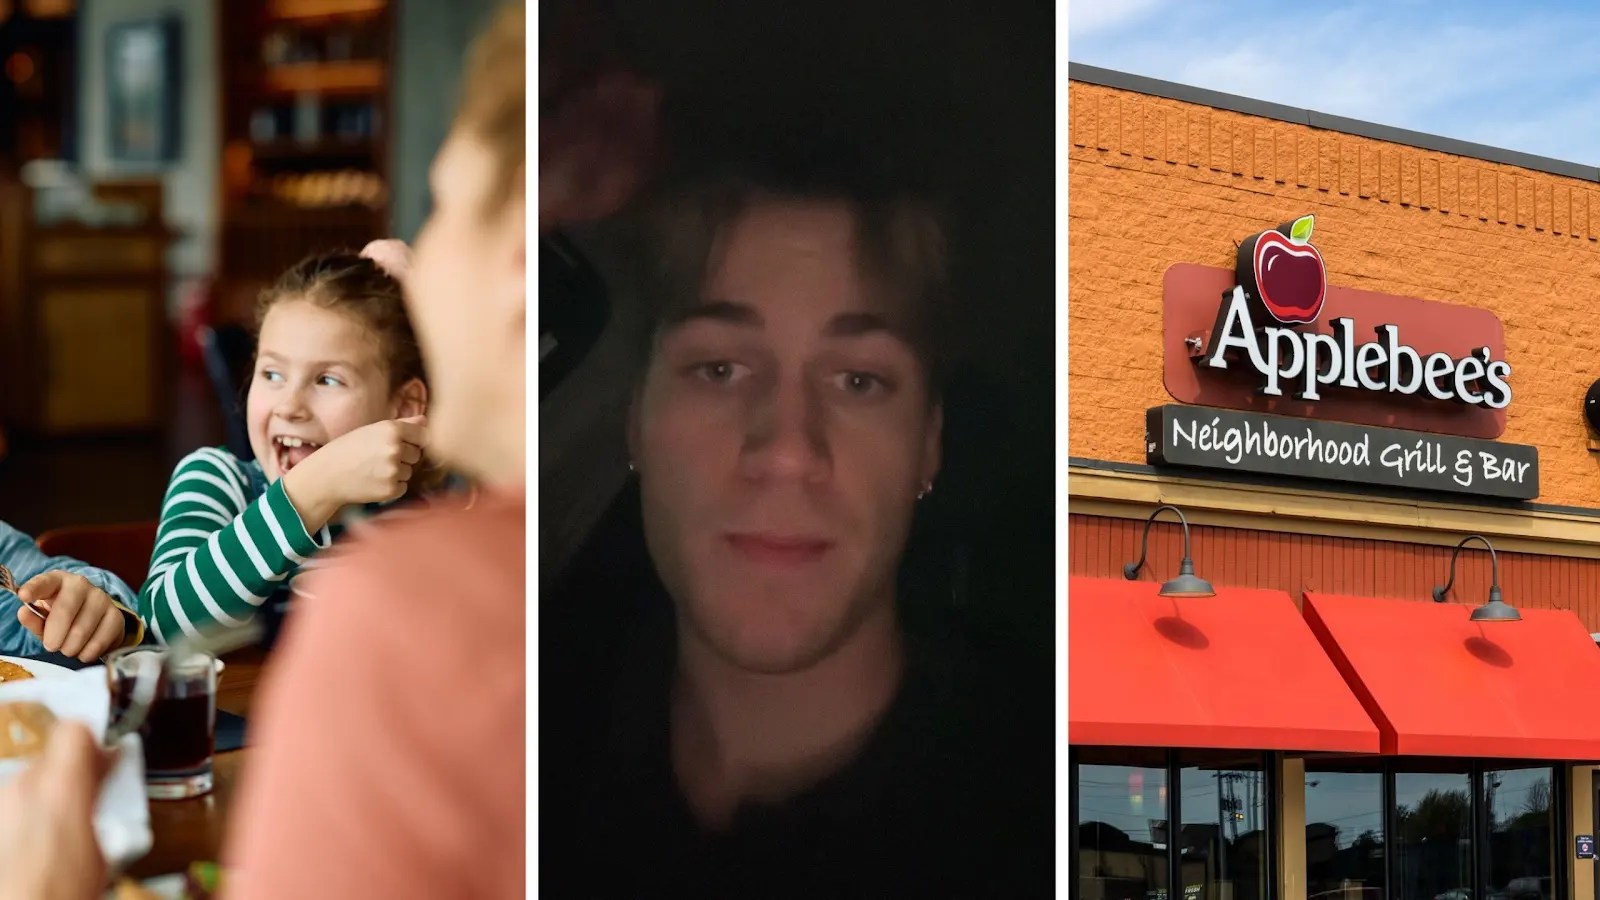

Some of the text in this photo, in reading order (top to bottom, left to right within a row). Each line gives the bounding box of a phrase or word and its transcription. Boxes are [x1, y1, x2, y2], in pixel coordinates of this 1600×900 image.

[1208, 284, 1512, 410] Applebee's
[1172, 416, 1530, 486] Neighborhood Grill & Bar
